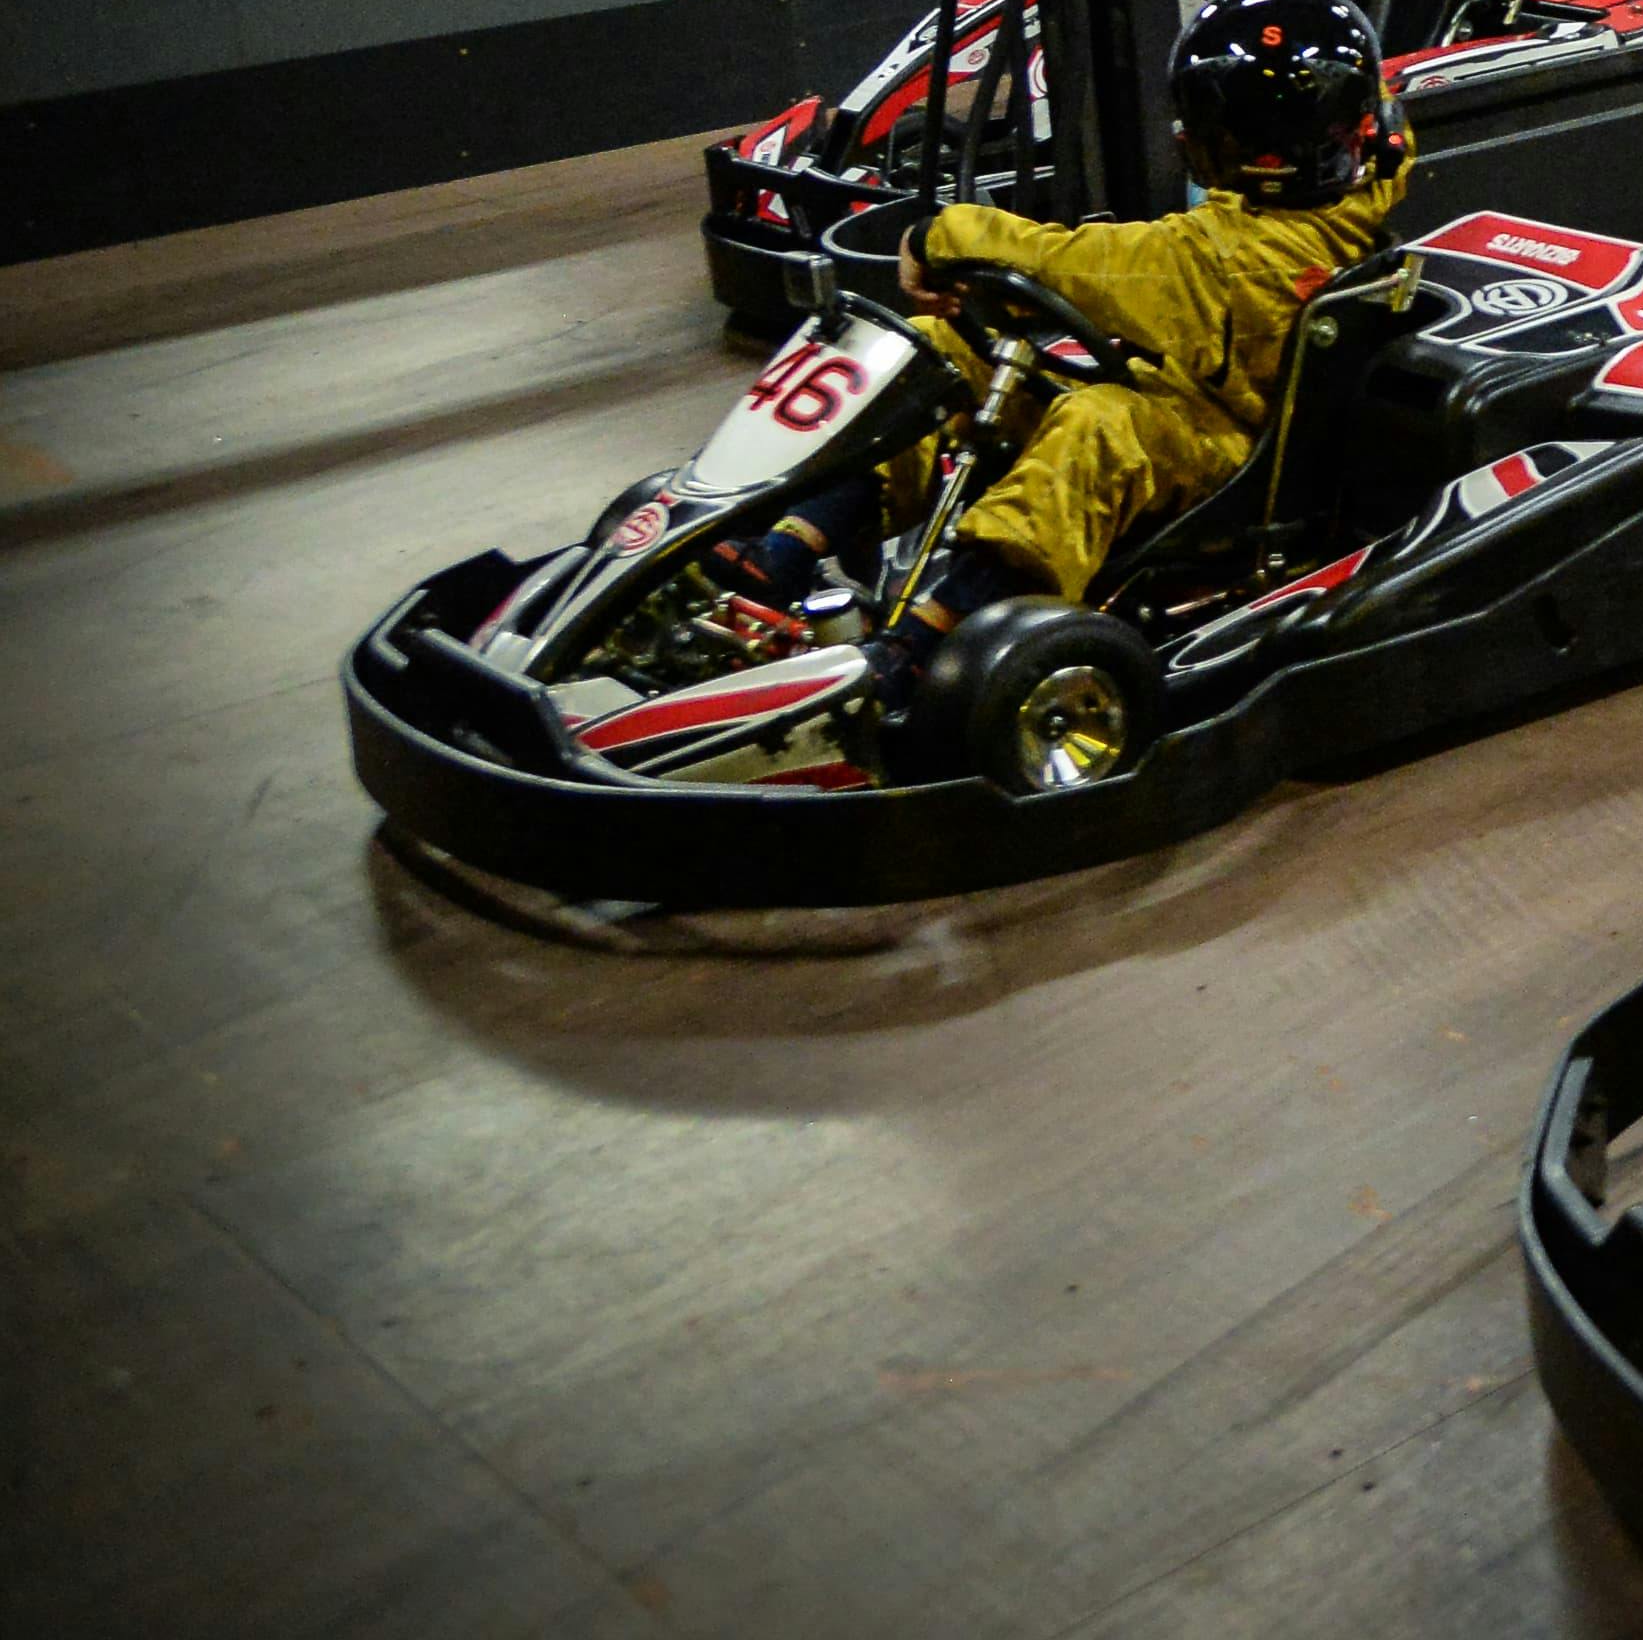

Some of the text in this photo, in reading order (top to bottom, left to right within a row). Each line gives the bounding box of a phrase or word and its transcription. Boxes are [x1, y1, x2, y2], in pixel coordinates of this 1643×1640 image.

[1261, 25, 1282, 46] S
[1485, 232, 1582, 267] BIZKARTS
[746, 341, 869, 432] 46
